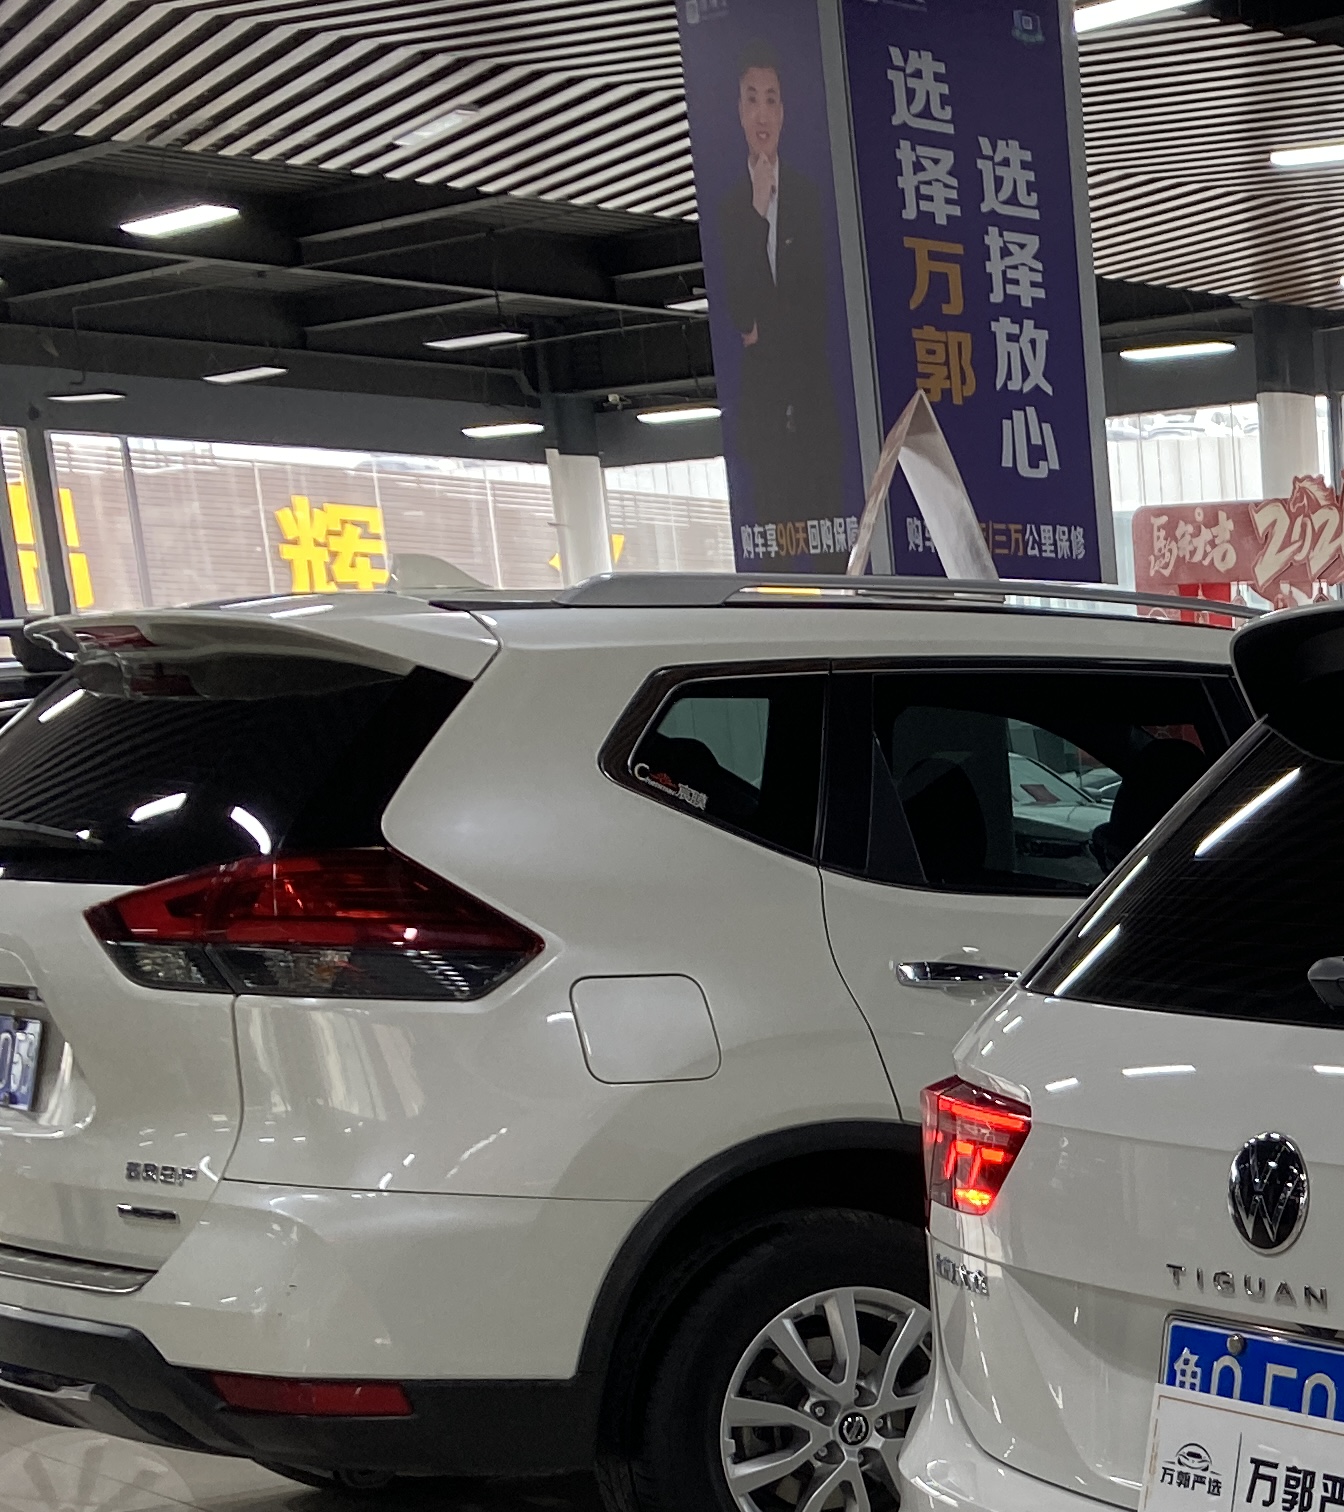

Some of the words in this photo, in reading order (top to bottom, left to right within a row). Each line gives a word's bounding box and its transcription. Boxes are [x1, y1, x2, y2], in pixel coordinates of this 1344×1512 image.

[886, 45, 976, 405] 选择万郭
[976, 136, 1060, 479] 选择放心
[274, 495, 391, 593] 辉
[1166, 1262, 1328, 1310] TIGUAN
[1159, 1465, 1223, 1498] 万郭严选
